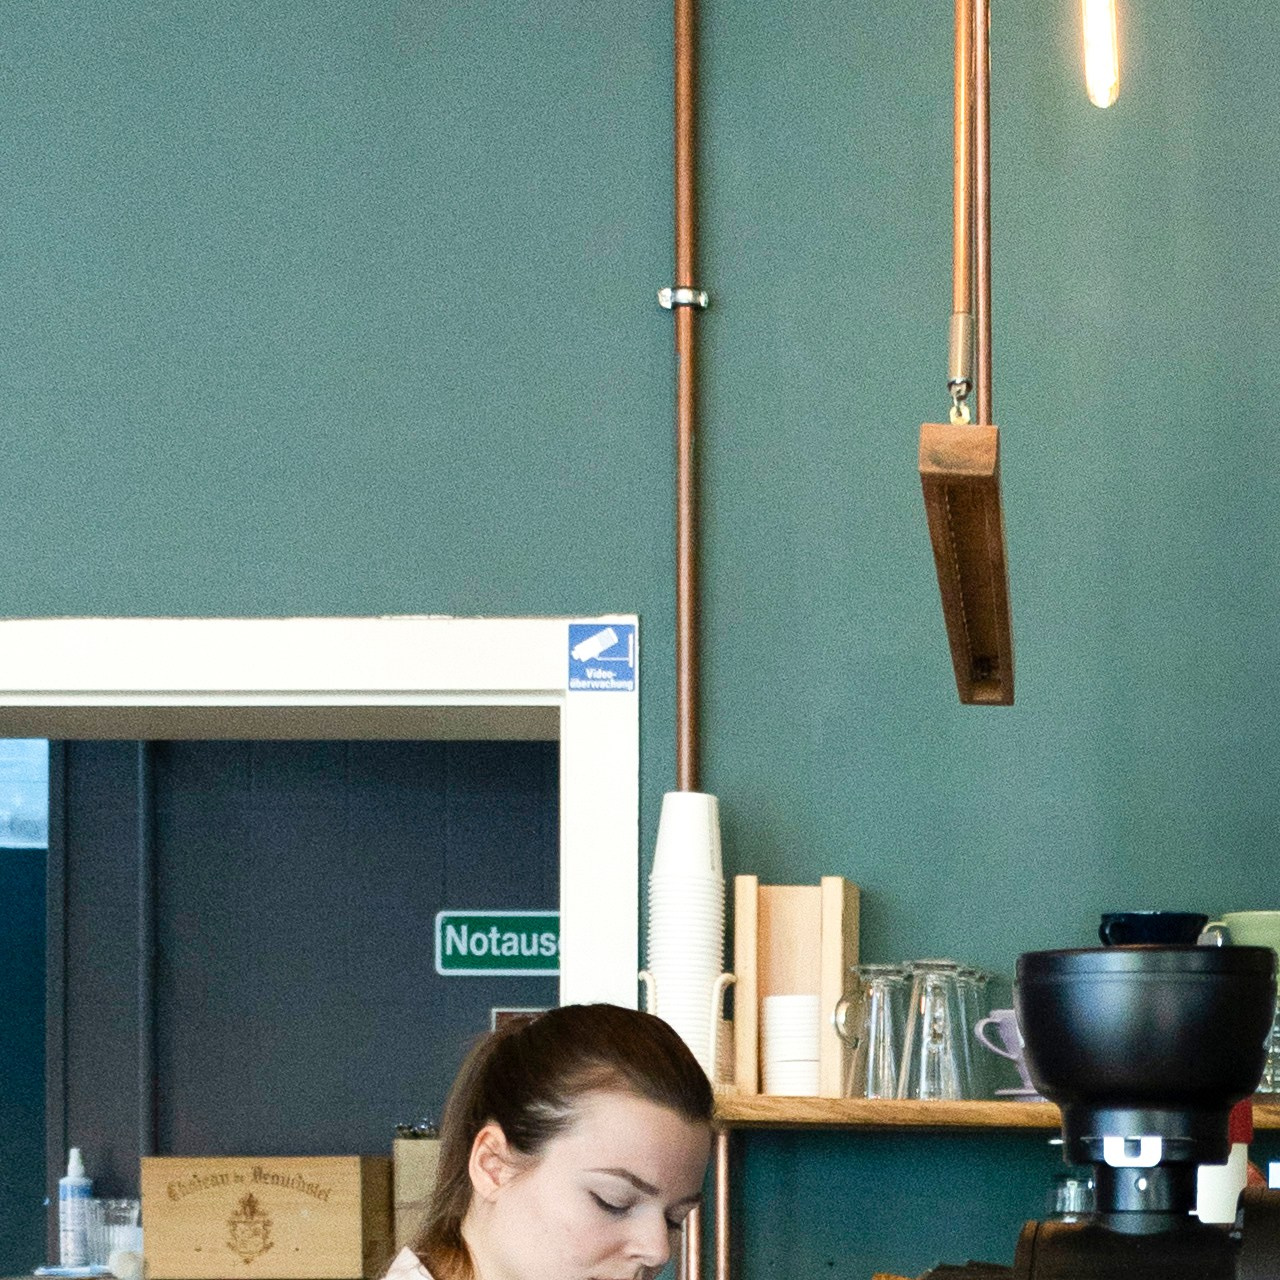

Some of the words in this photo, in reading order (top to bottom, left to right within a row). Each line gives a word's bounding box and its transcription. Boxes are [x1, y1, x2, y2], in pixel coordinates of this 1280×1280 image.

[586, 668, 617, 679] Video-
[570, 678, 634, 691] überwachung
[445, 924, 560, 956] Notaus
